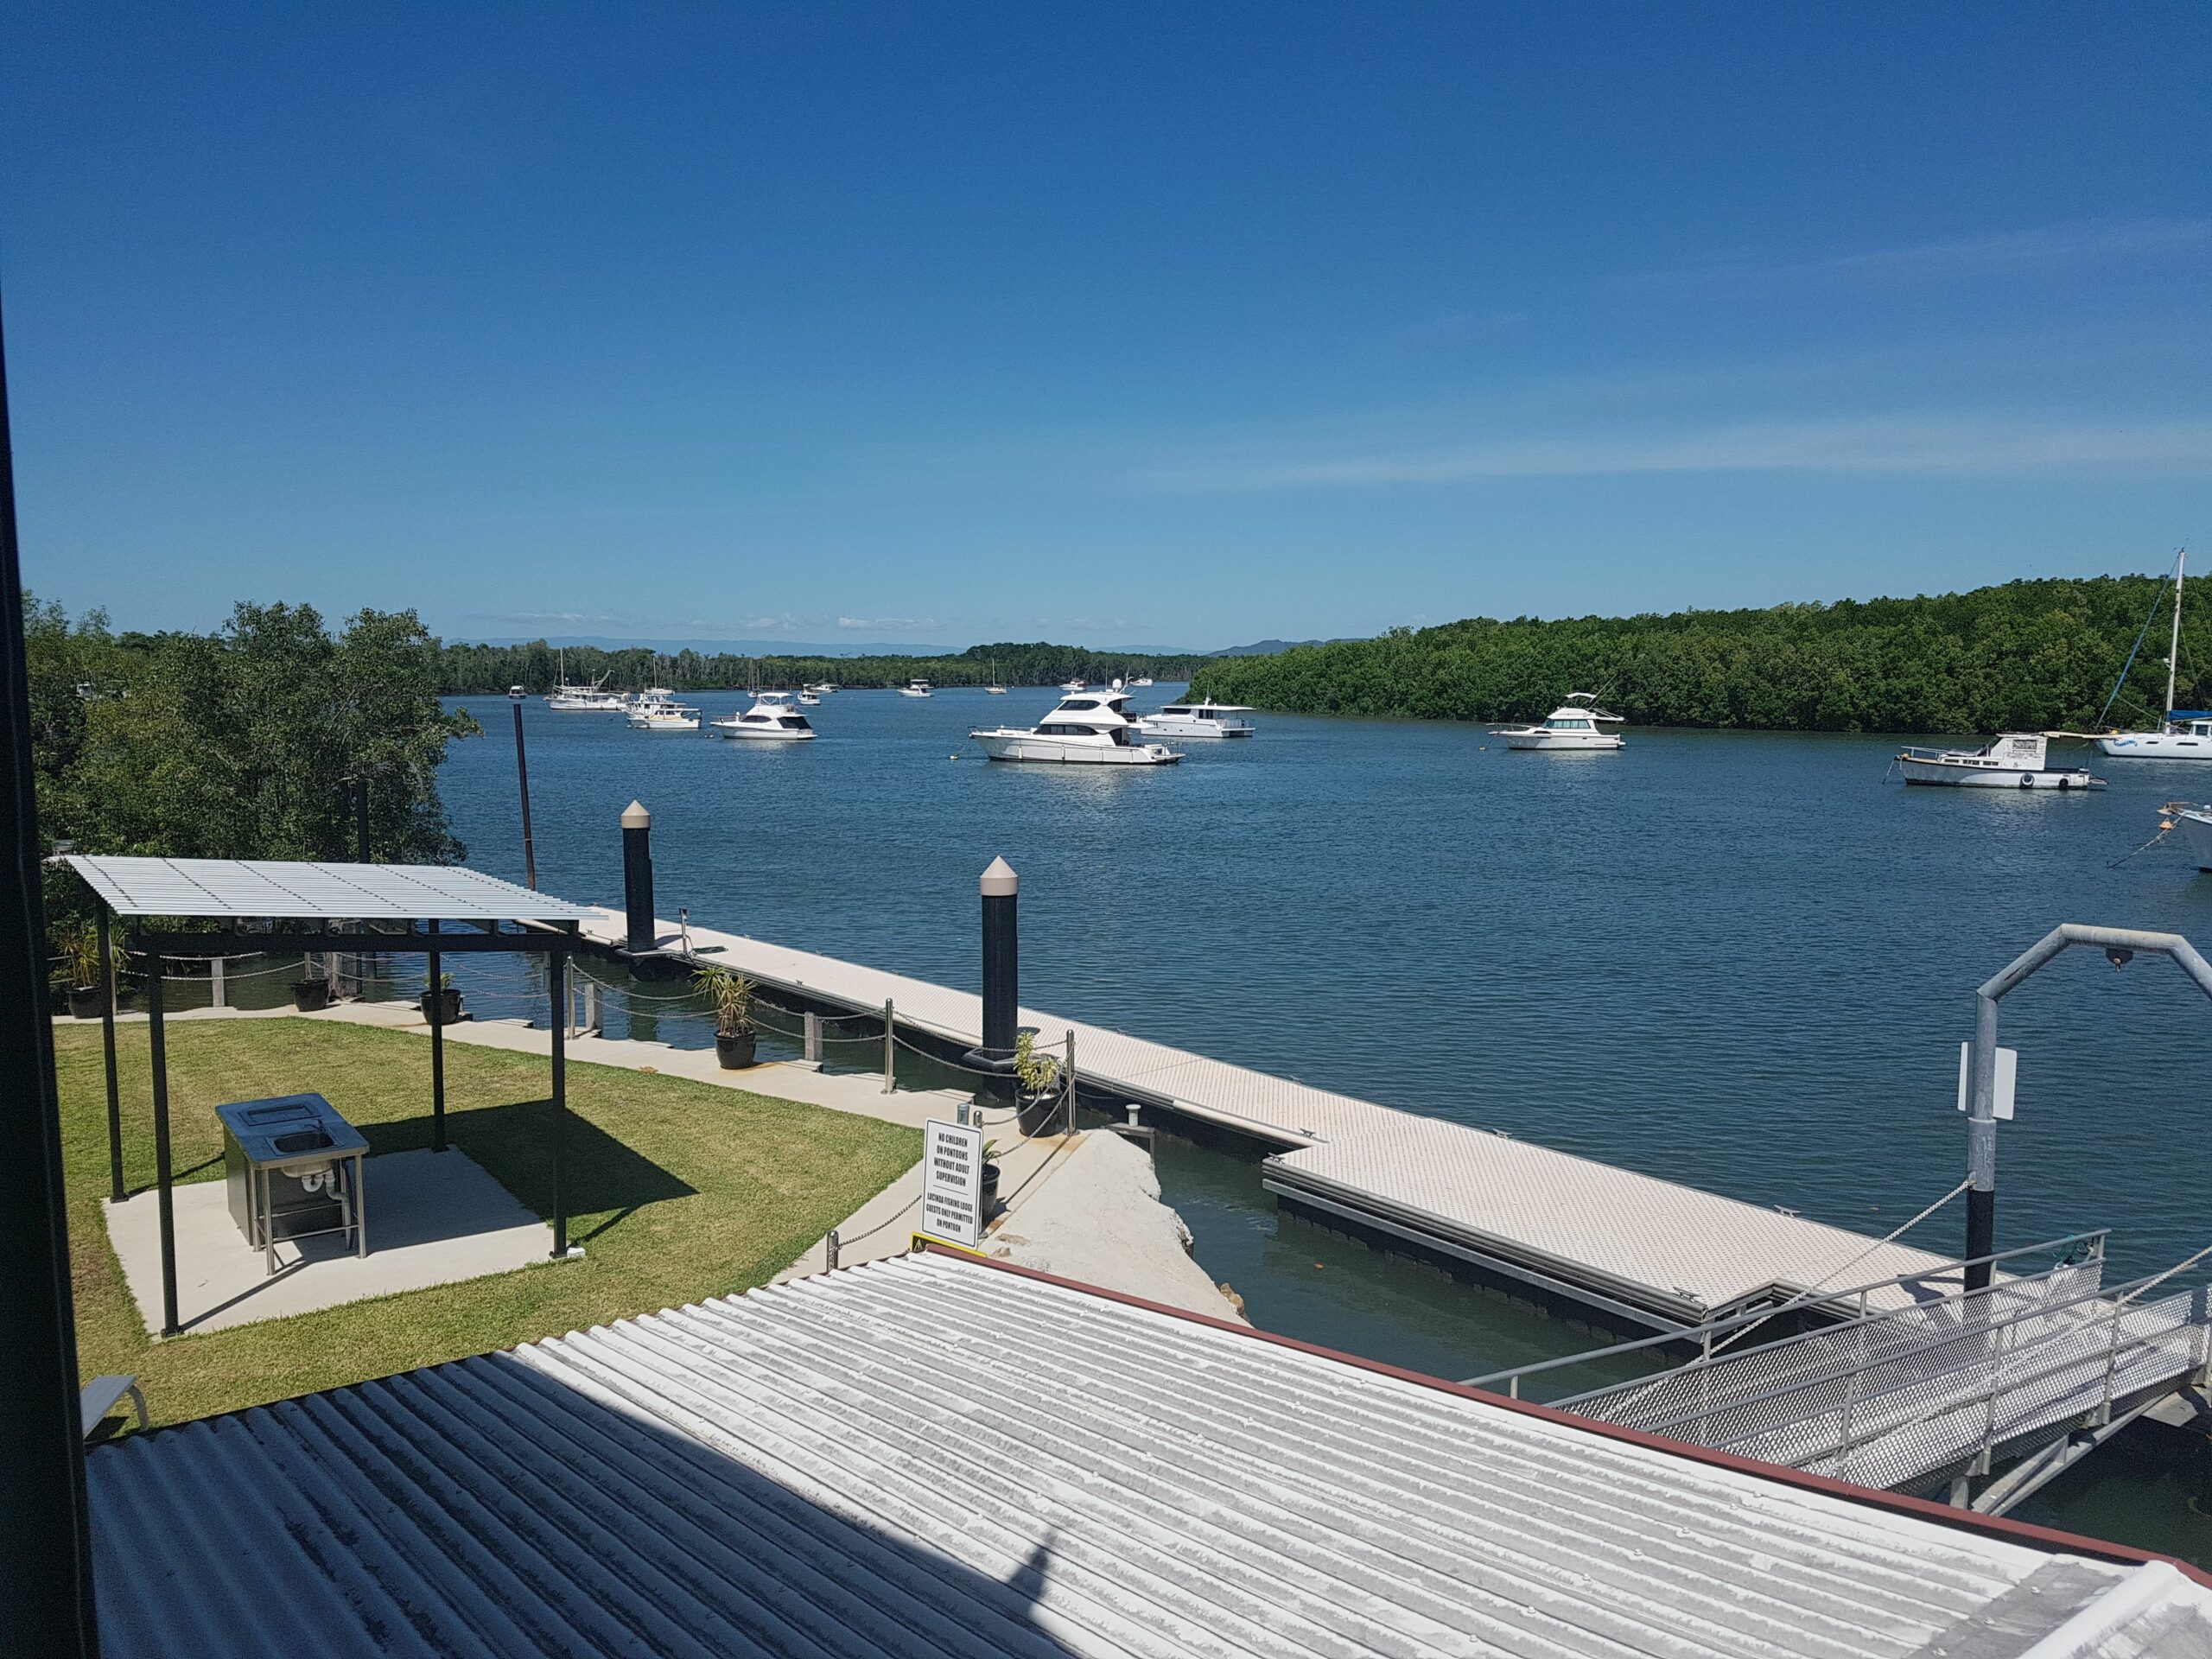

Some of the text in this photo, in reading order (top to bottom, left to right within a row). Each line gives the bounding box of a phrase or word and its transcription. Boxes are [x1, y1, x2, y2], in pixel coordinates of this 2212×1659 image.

[938, 1132, 968, 1147] NO CHILDREN
[937, 1145, 968, 1160] ON PONTOONS
[934, 1157, 969, 1174] WITHOUT ADULT
[936, 1171, 966, 1186] SUPERVISION
[944, 1197, 959, 1208] FISHING
[926, 1204, 973, 1224] GUESTS ONLY PERMITTED
[937, 1218, 961, 1233] ON PONTOON
